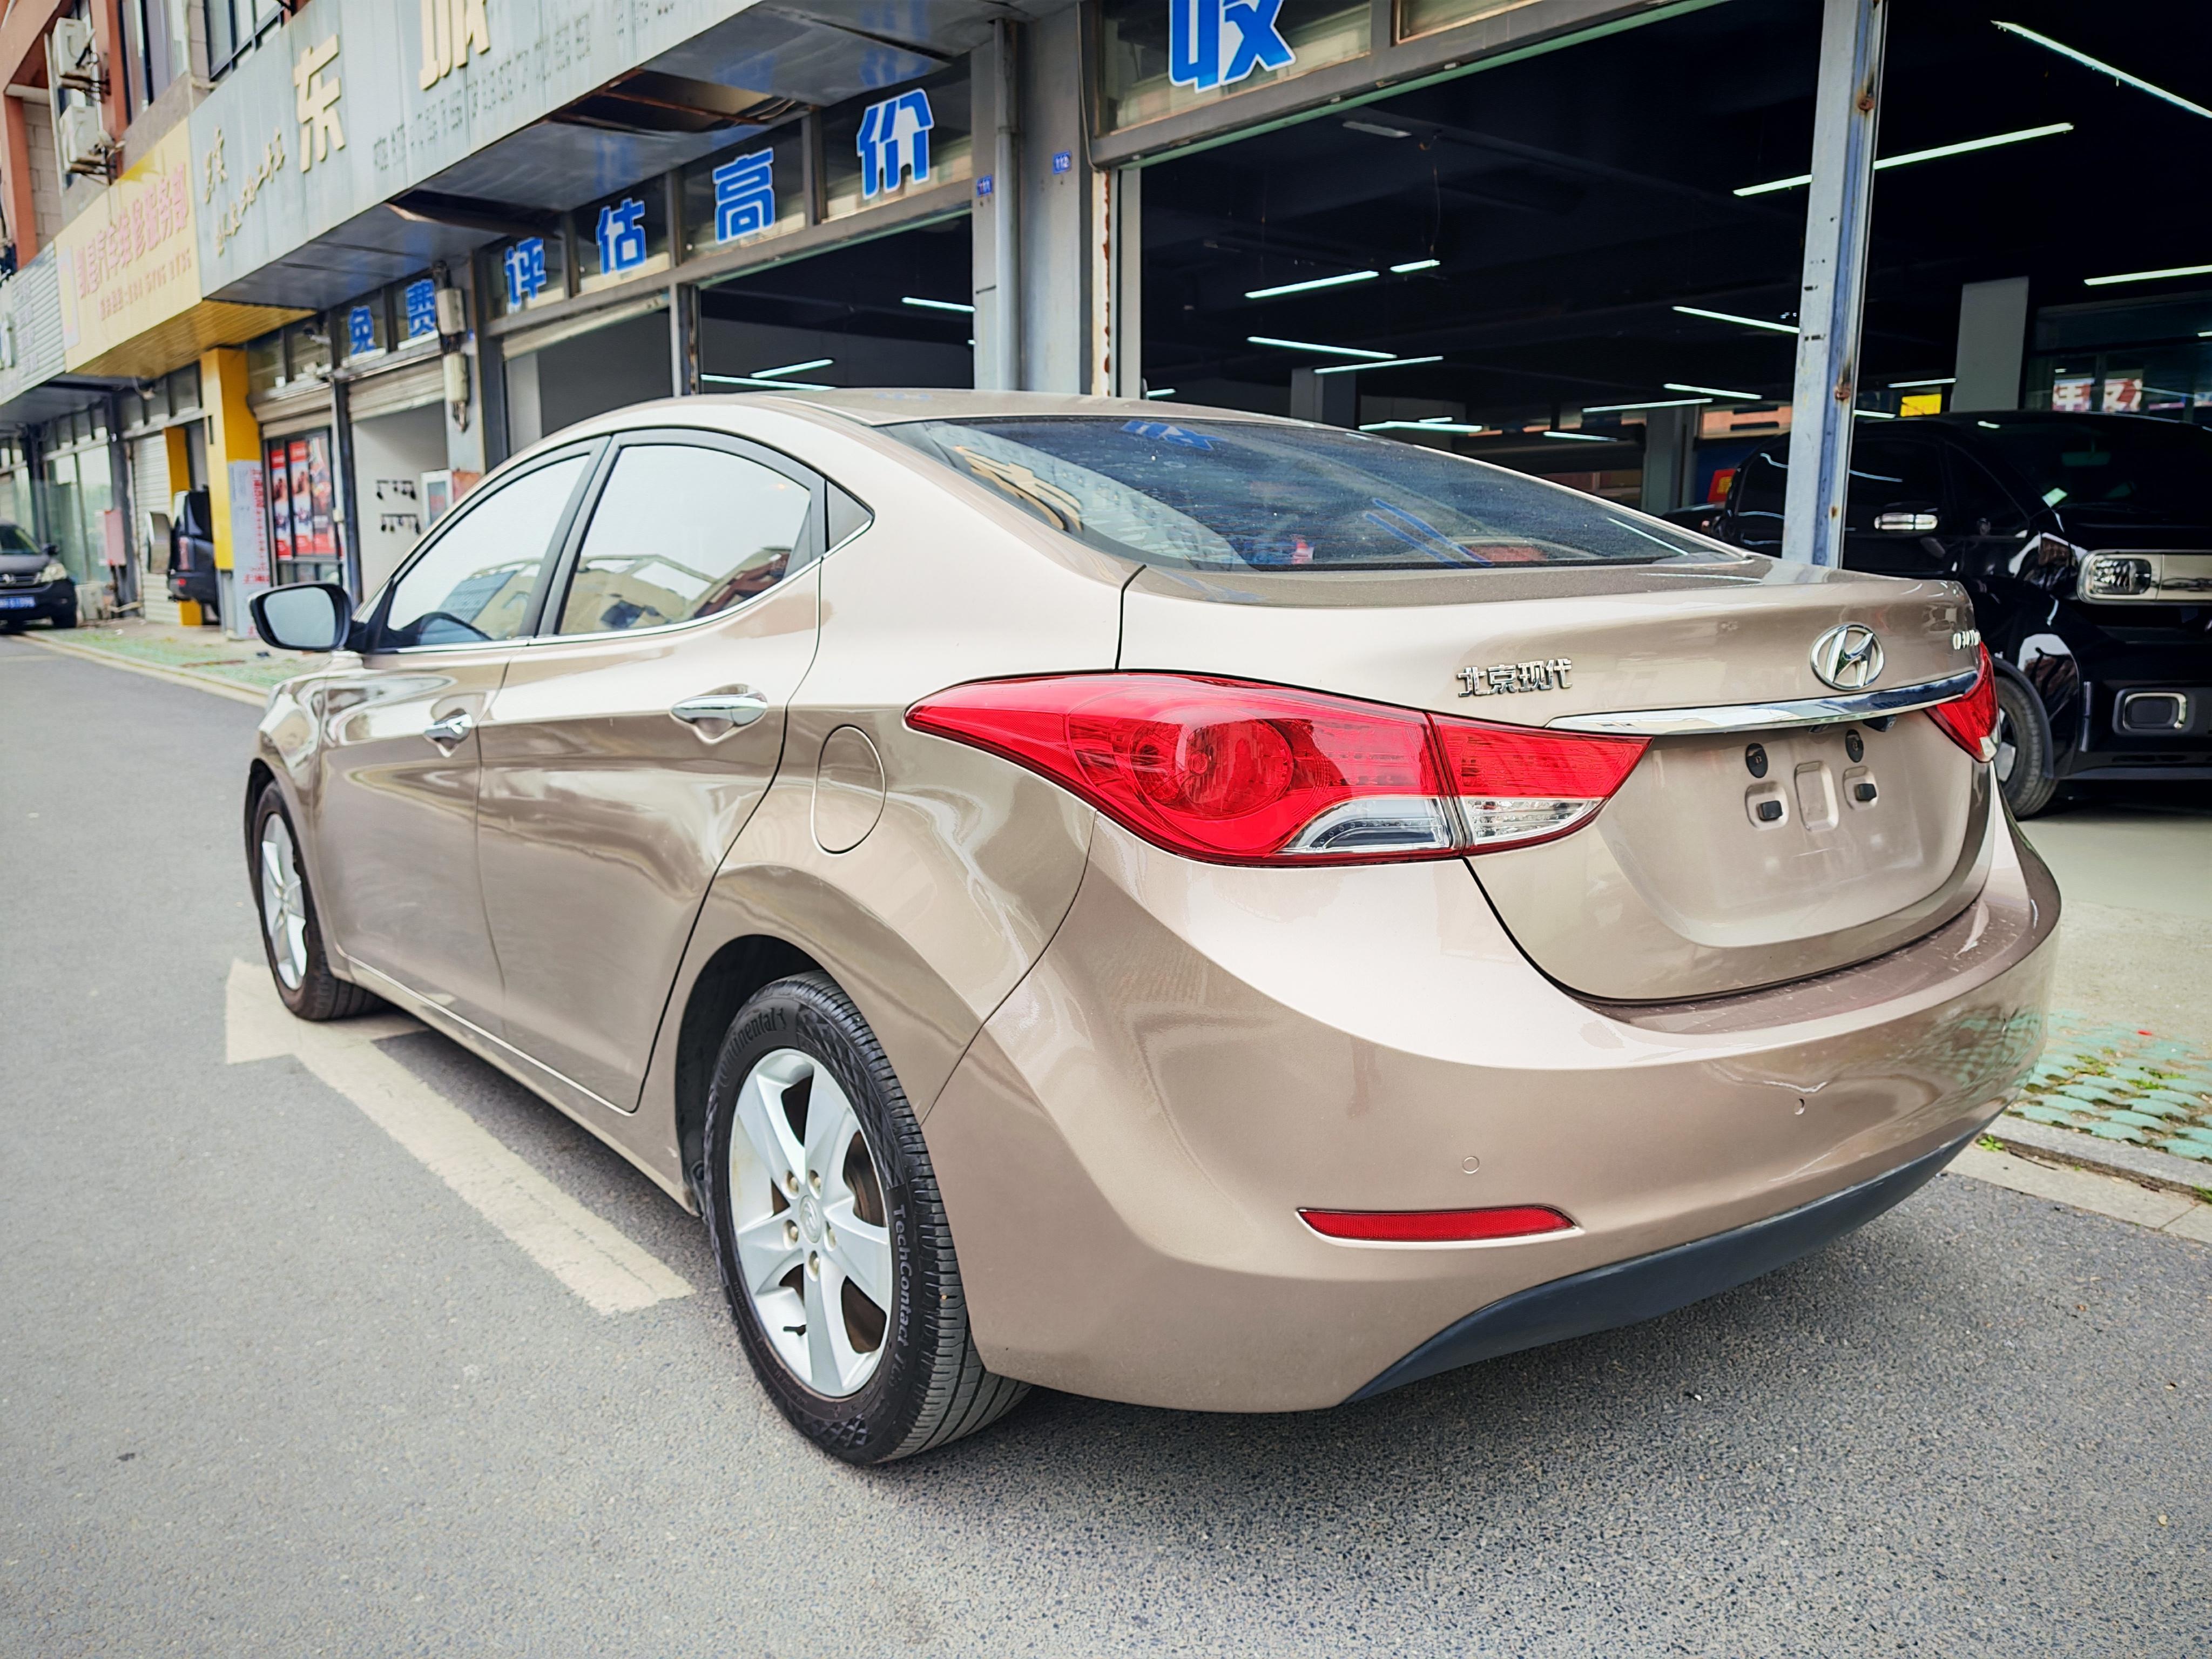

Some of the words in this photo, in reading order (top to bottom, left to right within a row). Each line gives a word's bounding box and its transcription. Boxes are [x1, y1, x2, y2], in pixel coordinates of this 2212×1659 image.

[1456, 658, 1573, 697] 北京现代
[893, 1204, 913, 1346] TechContact
